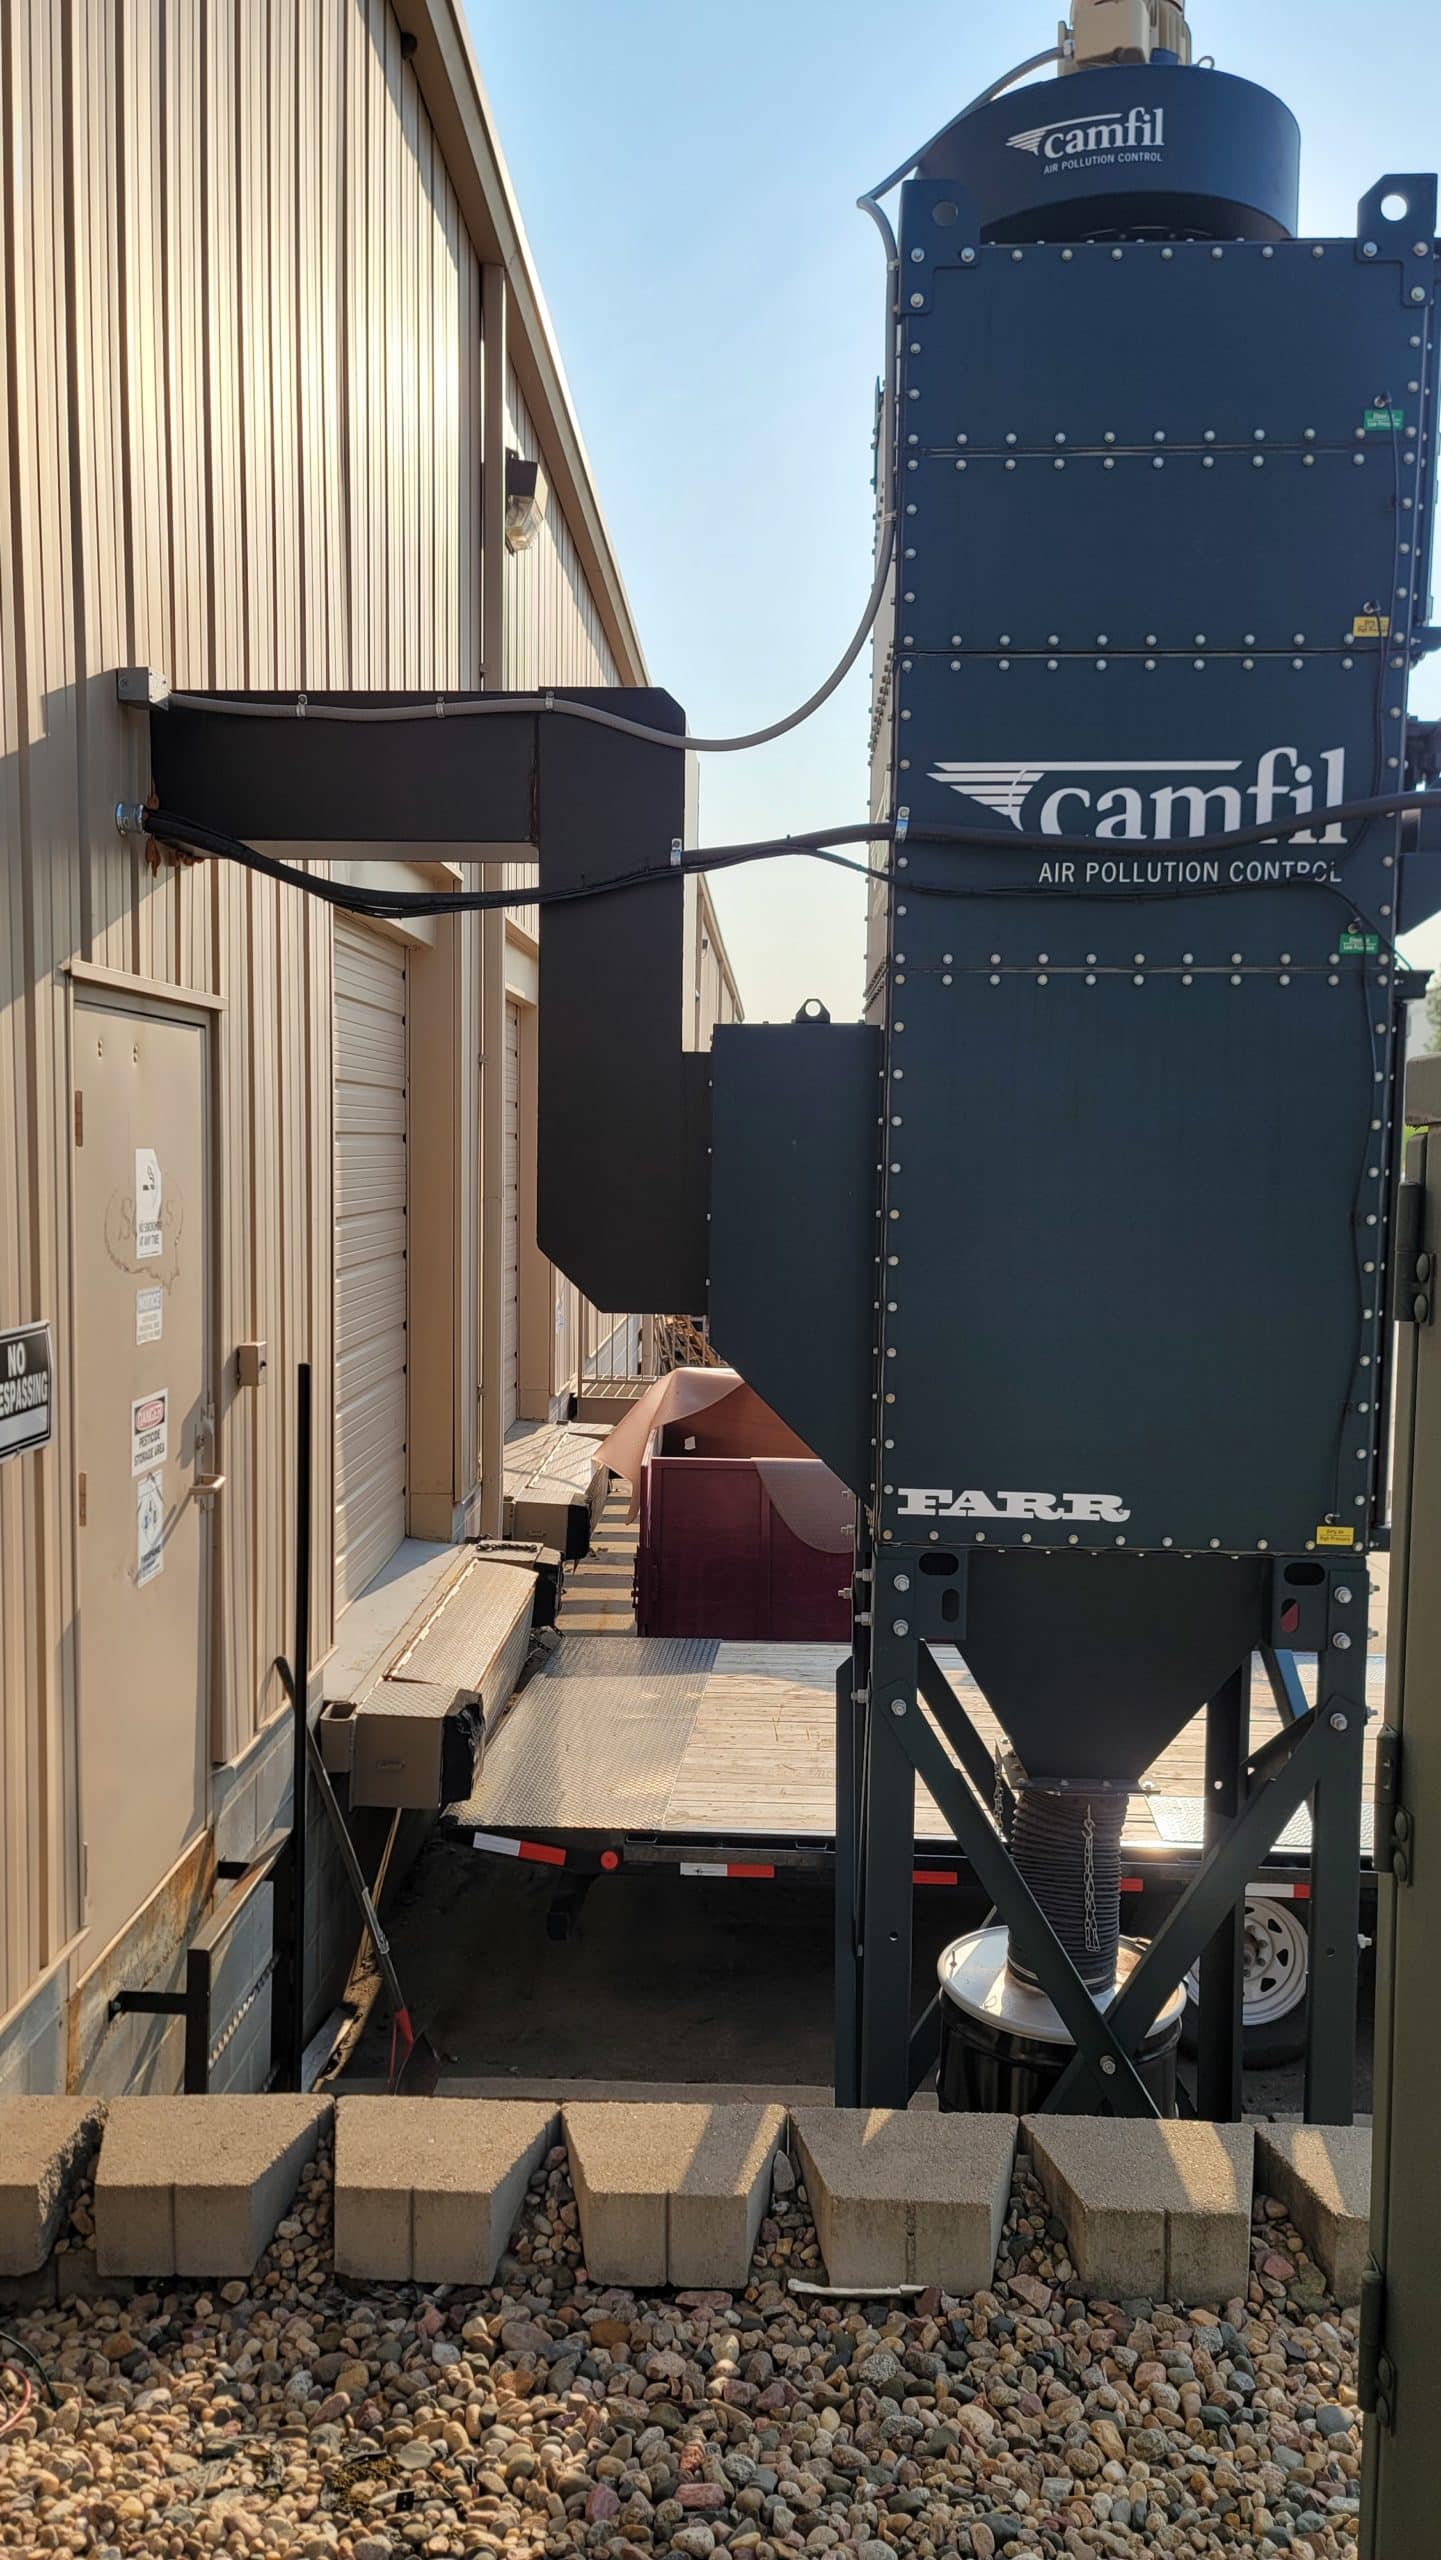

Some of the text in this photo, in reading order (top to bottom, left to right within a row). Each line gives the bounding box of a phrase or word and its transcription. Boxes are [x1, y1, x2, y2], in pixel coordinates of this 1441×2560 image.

[1044, 106, 1165, 159] camfil
[1044, 151, 1163, 175] AIR POLLUTION CONTROL
[1040, 746, 1349, 844] camfil
[1038, 862, 1075, 883] AIR
[1085, 861, 1220, 883] POLLUTION
[7, 1341, 26, 1378] NO
[154, 1442, 165, 1456] AREA
[897, 1487, 1132, 1522] FARR
